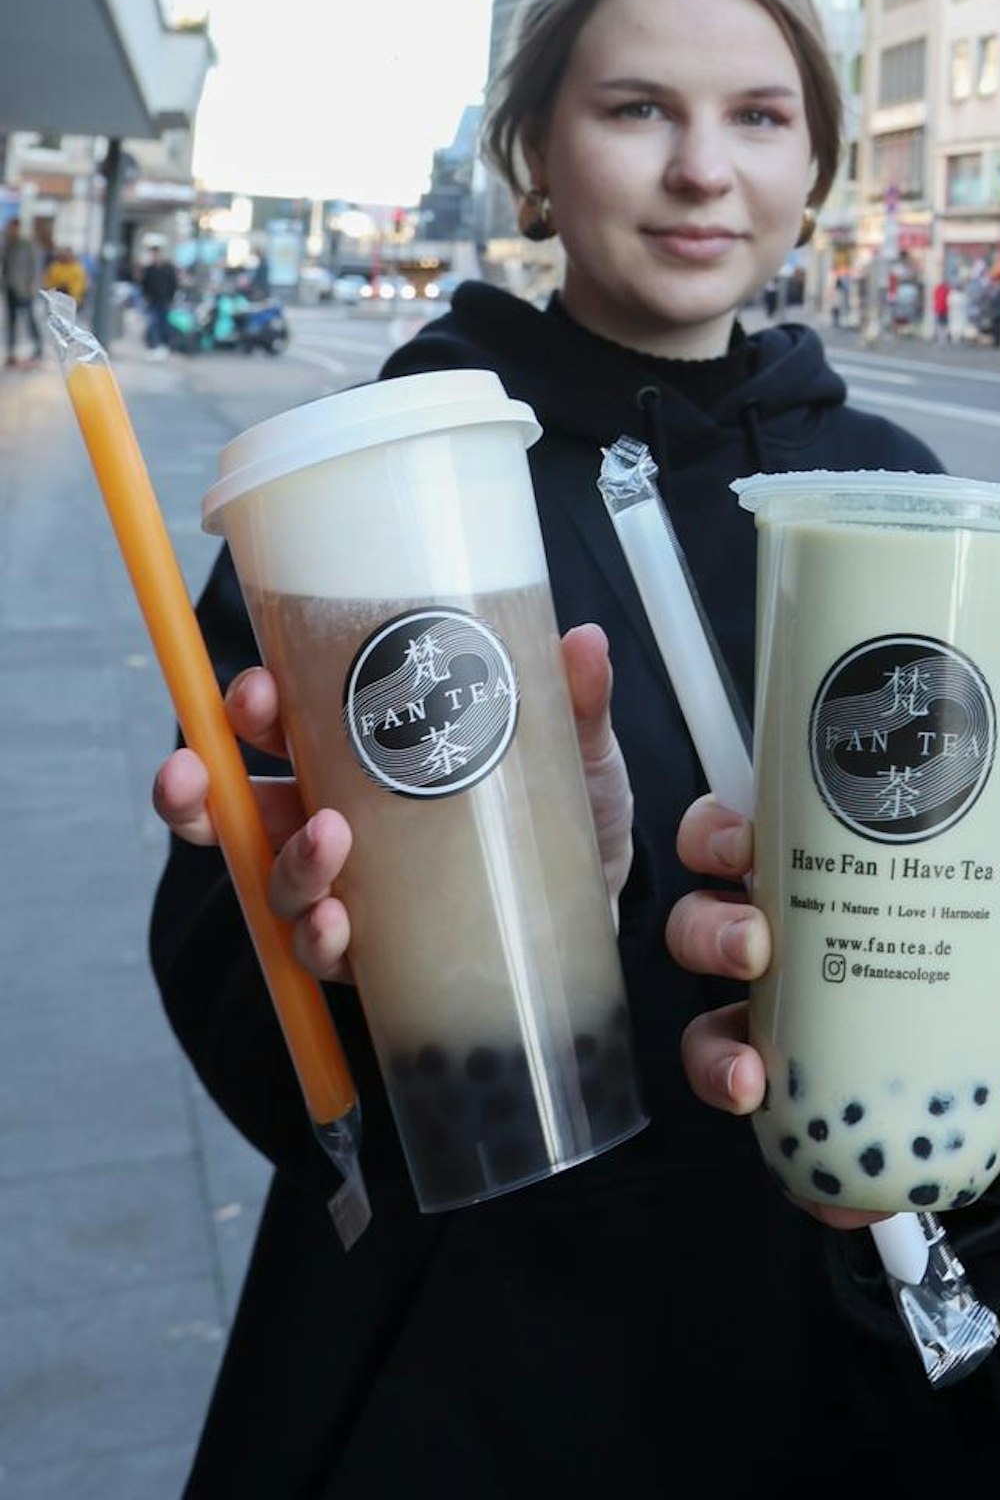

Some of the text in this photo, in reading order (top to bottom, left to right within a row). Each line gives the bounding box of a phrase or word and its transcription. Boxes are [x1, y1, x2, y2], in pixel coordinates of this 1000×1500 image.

[403, 634, 451, 689] 梵
[360, 677, 511, 737] FAN TEA
[881, 666, 930, 717] 梵
[420, 721, 471, 776] 茶
[825, 726, 981, 758] FAN TEA
[874, 765, 923, 818] 茶
[791, 849, 836, 873] Have
[840, 855, 878, 876] Fan
[902, 858, 956, 880] Have
[961, 860, 994, 881] Tea
[841, 901, 880, 916] Nature
[897, 905, 927, 918] Love
[825, 936, 952, 956] www.fantea.de
[851, 963, 951, 984] @fanteacologne
